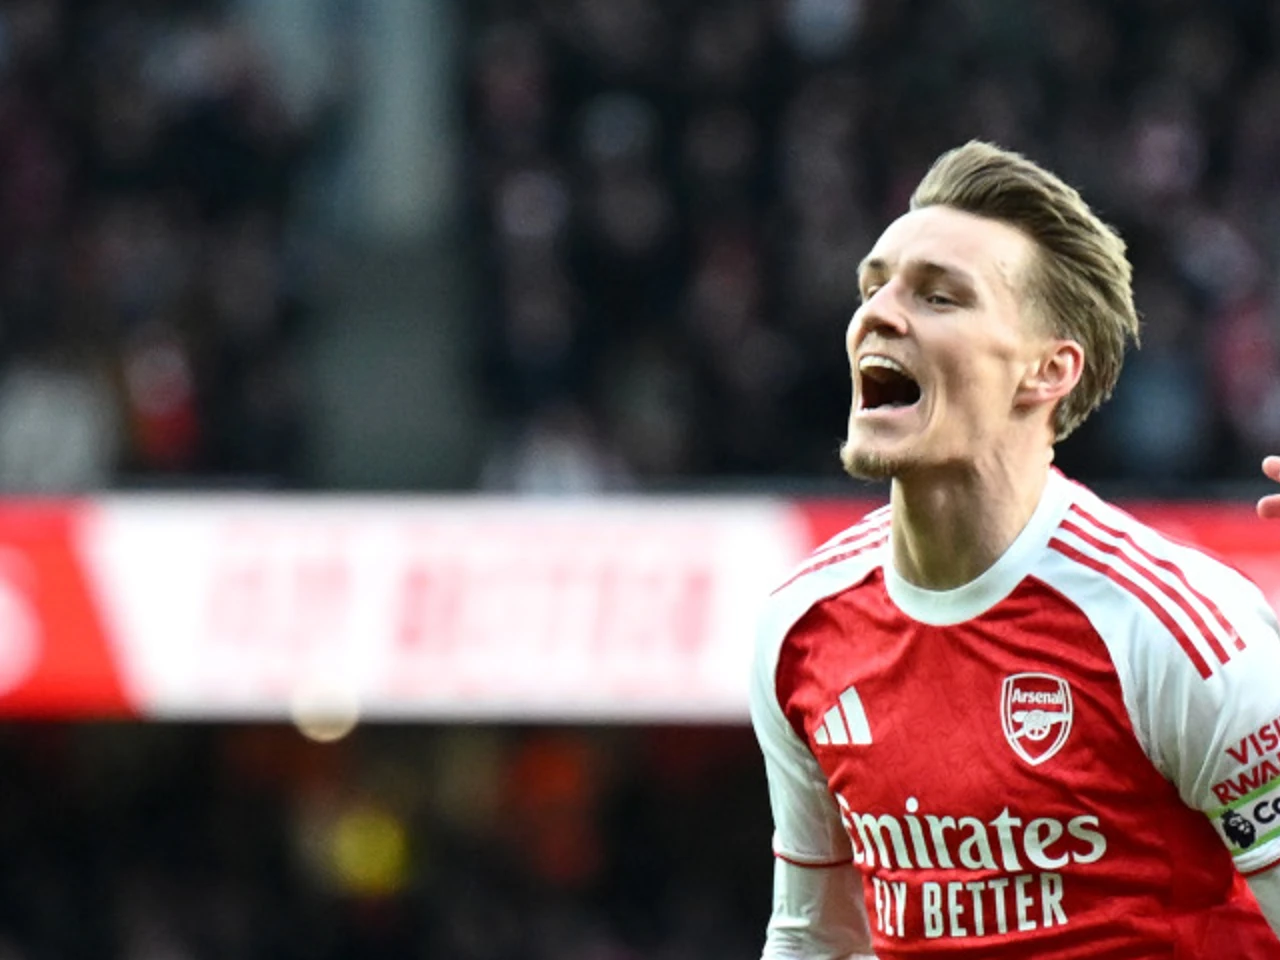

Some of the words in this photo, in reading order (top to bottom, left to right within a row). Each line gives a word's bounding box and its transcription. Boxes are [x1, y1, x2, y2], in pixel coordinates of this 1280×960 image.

[1011, 688, 1063, 704] Arsenal
[834, 793, 1107, 872] Emirates
[872, 876, 907, 937] FLY
[921, 872, 1069, 938] BETTER
